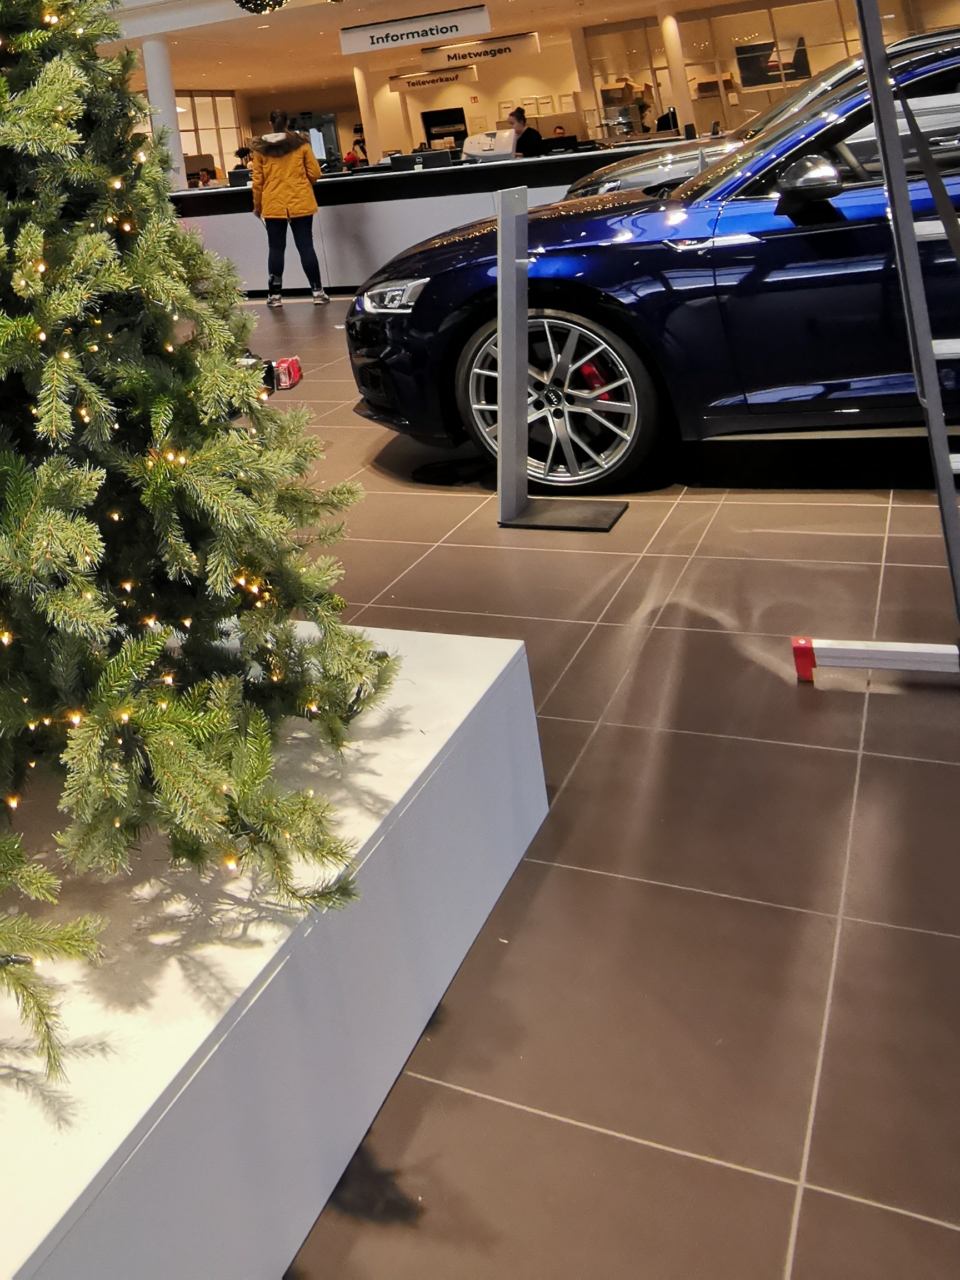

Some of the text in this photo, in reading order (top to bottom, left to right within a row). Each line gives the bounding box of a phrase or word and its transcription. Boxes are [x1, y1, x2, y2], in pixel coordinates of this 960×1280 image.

[369, 24, 459, 45] Information
[447, 46, 511, 62] Mietwagen
[406, 74, 459, 87] Teileverkauf
